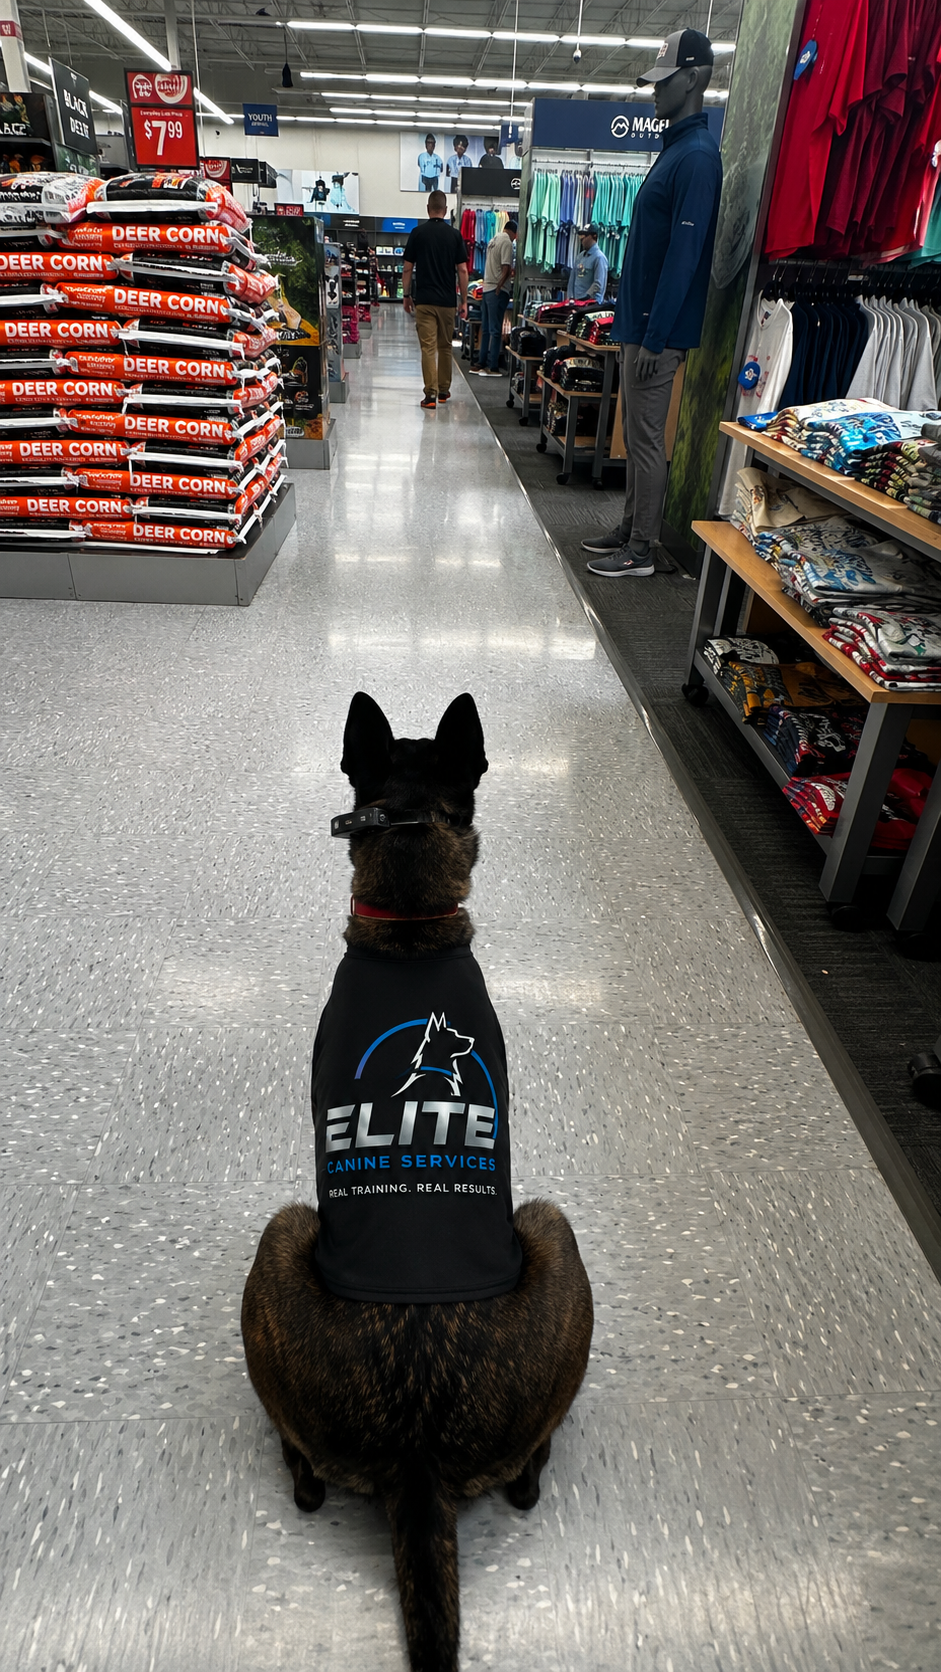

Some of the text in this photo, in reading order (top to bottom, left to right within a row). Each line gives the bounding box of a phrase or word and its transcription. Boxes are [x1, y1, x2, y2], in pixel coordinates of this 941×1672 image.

[248, 113, 272, 122] YOUTH
[112, 225, 161, 242] DEER
[167, 226, 219, 244] CORN
[0, 255, 103, 271] DEER CORN
[114, 290, 162, 308] DEER
[168, 295, 220, 314] CORN
[5, 322, 108, 338] DEER CORN
[124, 357, 169, 373] DEER
[175, 360, 225, 378] CORN
[12, 382, 112, 395] DEER CORN
[124, 417, 169, 432] DEER
[175, 420, 223, 437] CORN
[19, 443, 63, 455] DEER
[69, 443, 117, 456] CORN
[130, 474, 174, 488] DEER
[179, 478, 226, 493] CORN
[27, 499, 70, 512] DEER
[75, 499, 122, 513] CORN
[134, 524, 175, 539] DEER
[180, 529, 225, 543] CORN
[326, 1101, 496, 1152] ELITE
[328, 1154, 496, 1174] CANINE SERVICES
[329, 1184, 498, 1198] REAL TRAINING. REAL RESULTS.
